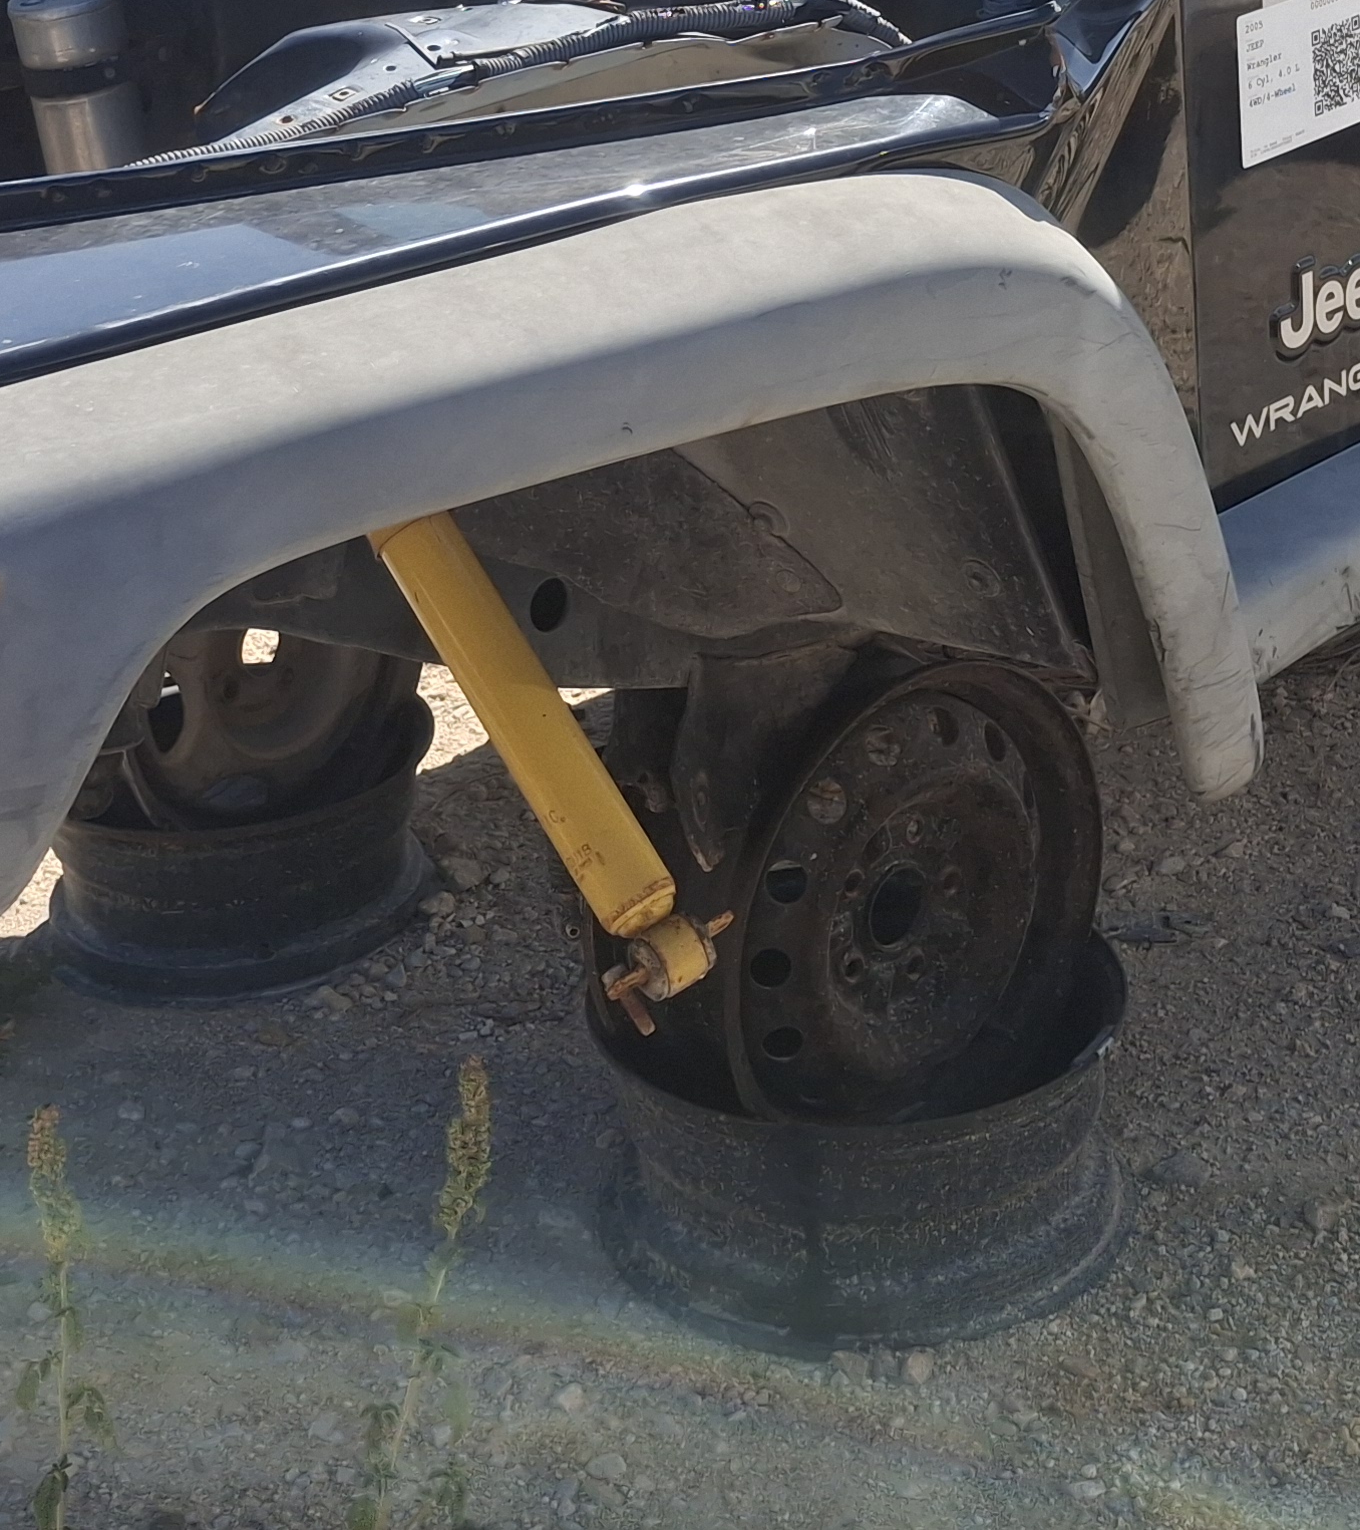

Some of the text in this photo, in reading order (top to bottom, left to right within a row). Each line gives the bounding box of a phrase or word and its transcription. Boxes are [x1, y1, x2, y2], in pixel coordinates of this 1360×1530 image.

[1245, 21, 1264, 34] 2005
[1246, 39, 1265, 53] JEEP
[1246, 53, 1282, 71] Wrangler
